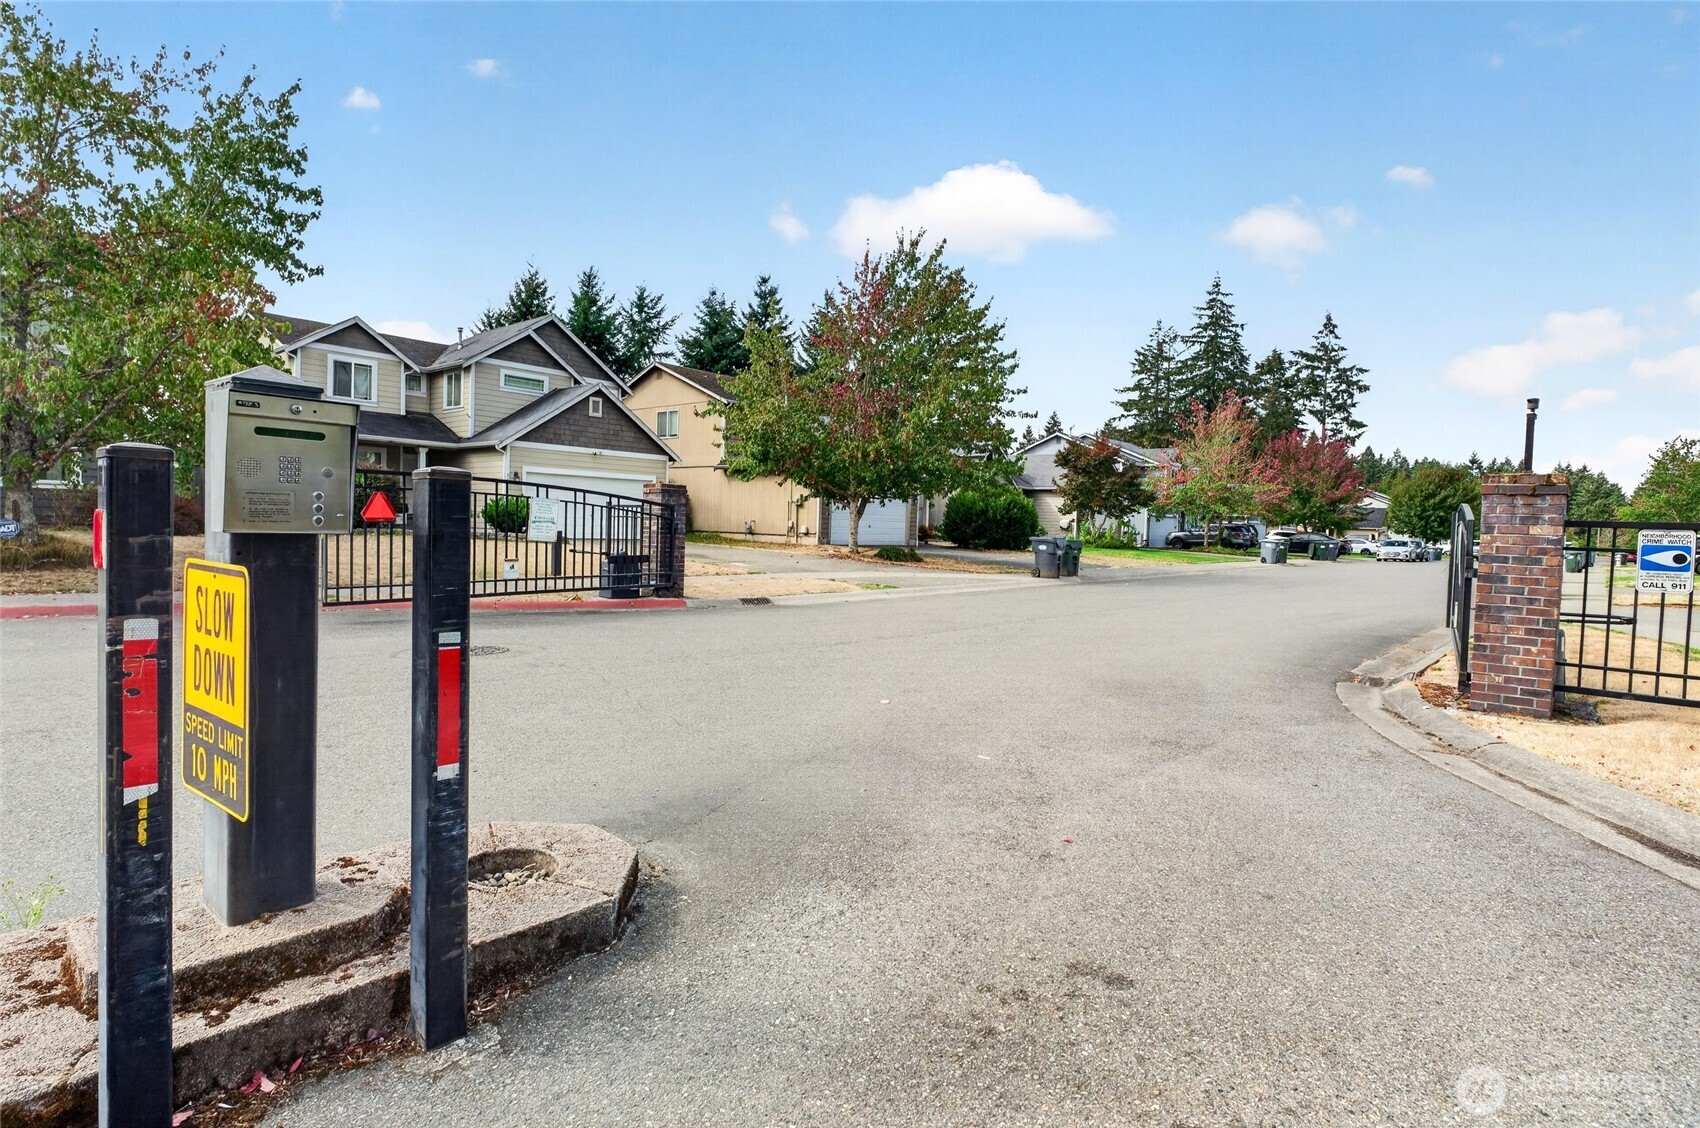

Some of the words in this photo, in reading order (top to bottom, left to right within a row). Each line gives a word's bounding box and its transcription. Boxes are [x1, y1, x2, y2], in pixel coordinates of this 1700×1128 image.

[195, 585, 235, 642] SLOW
[194, 643, 235, 706] DOWN
[186, 711, 215, 744] SPEED
[218, 726, 244, 760] LIMIT
[191, 743, 207, 782] 10
[213, 754, 237, 801] MPH
